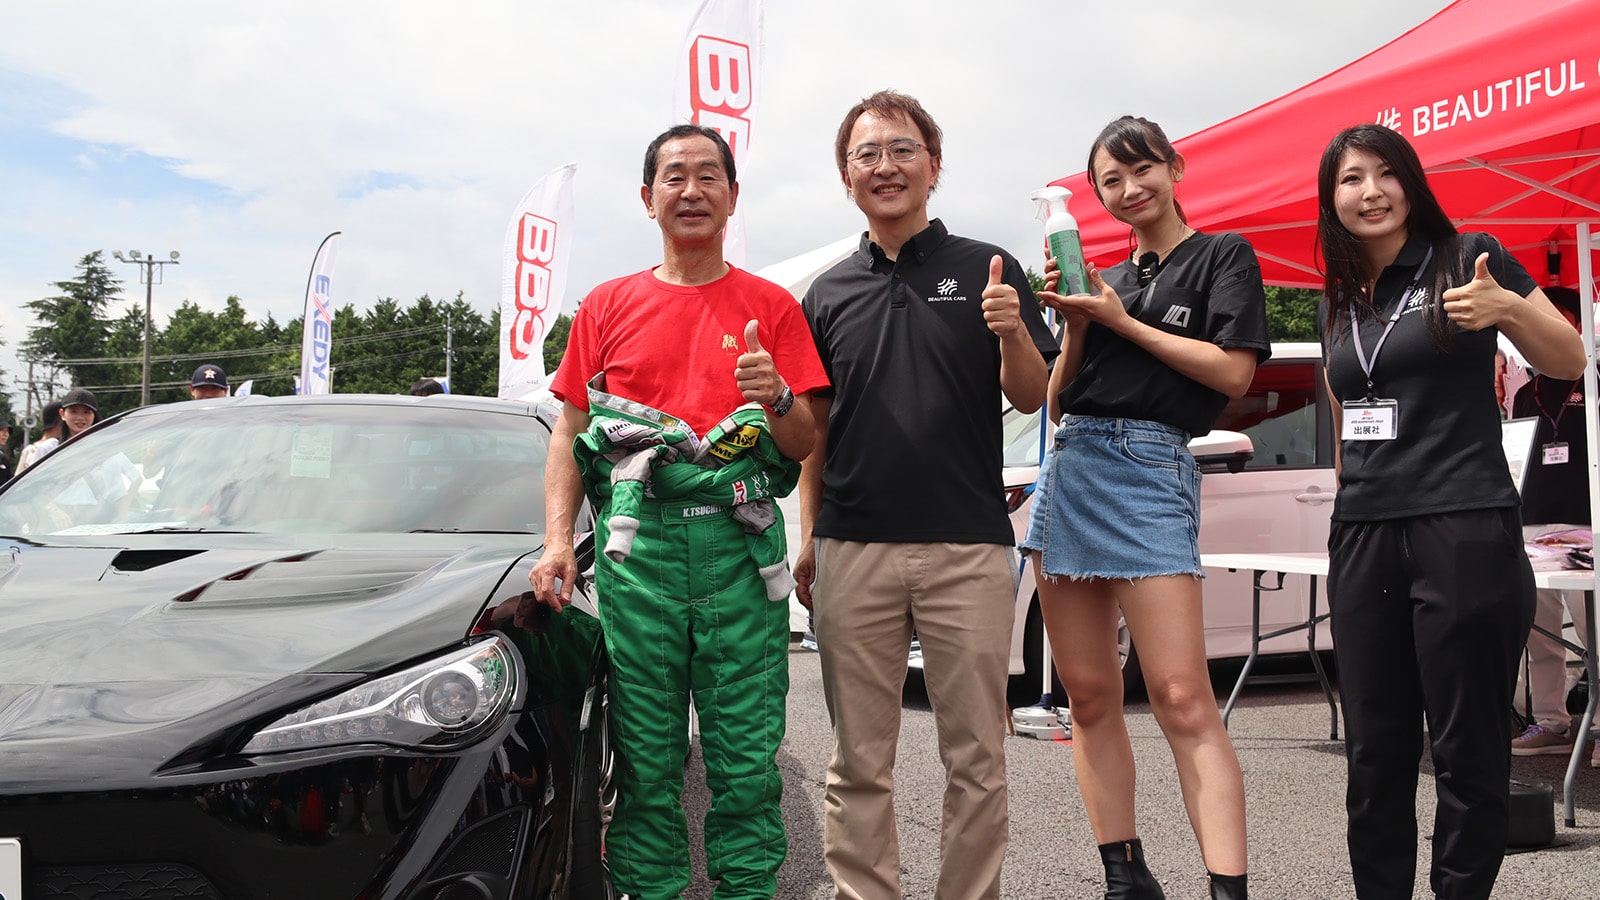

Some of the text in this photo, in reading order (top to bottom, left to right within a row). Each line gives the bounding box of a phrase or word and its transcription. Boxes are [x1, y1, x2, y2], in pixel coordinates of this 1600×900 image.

[1412, 58, 1586, 137] BEAUTIFUL
[312, 274, 332, 381] EXEDY
[1353, 425, 1380, 435] 出展社
